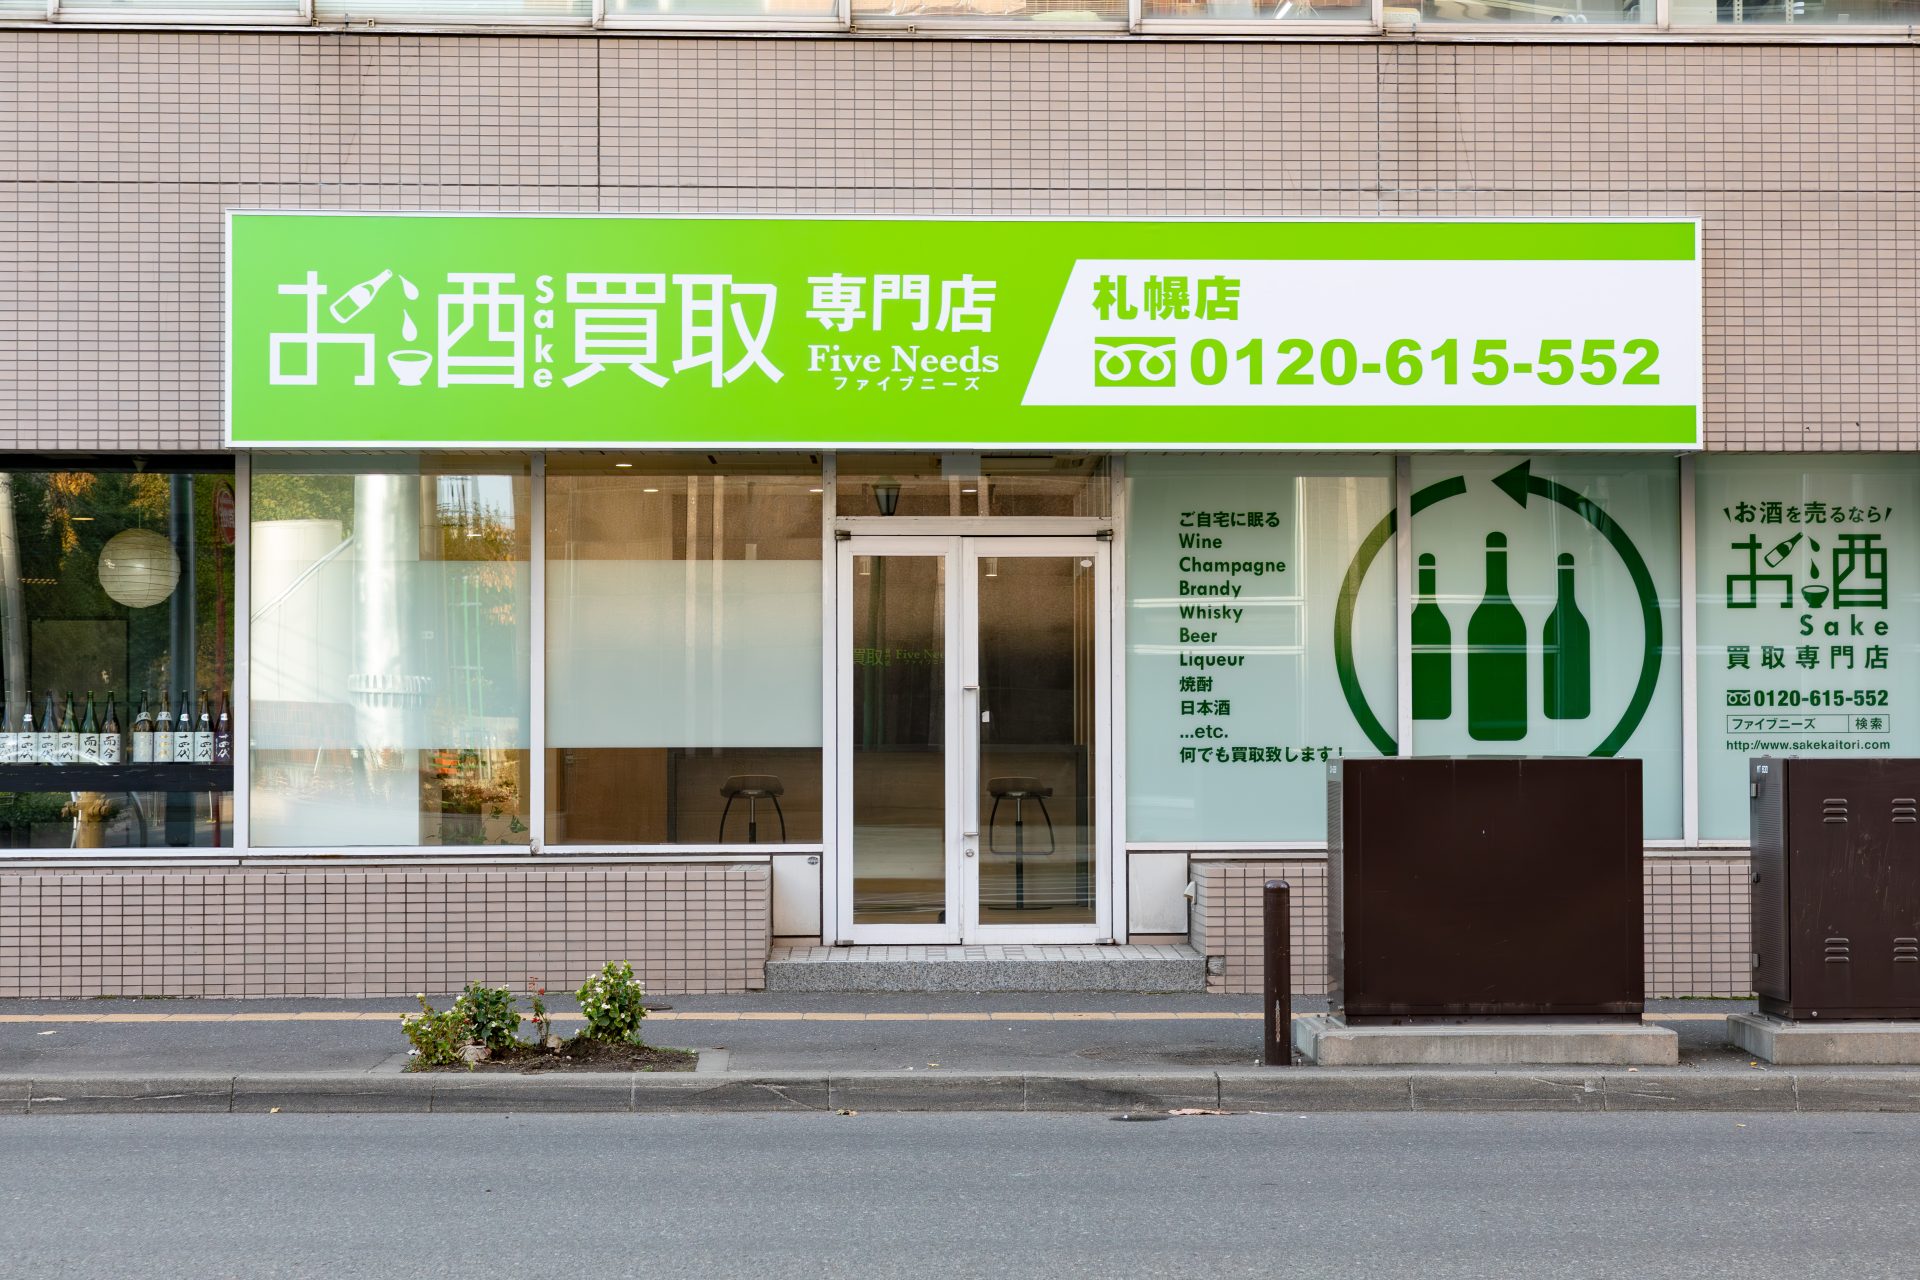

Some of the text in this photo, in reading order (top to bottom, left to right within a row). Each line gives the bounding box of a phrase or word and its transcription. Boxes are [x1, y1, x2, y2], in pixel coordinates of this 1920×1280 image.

[806, 273, 997, 333] 専門店
[1092, 274, 1241, 321] 札幌店
[533, 274, 555, 389] Sake
[562, 272, 785, 388] 買取
[807, 345, 999, 373] Five Needs
[1190, 338, 1660, 386] 0120-615-552
[834, 375, 980, 391] ファイブニーズ
[1179, 511, 1280, 528] ご自宅に眠る
[1179, 533, 1223, 549] Wine
[1179, 556, 1286, 576] Champagne
[1179, 580, 1242, 597] Brandy
[1179, 605, 1243, 623] Whisky
[1799, 614, 1889, 636] Sake
[1179, 627, 1218, 643] Beer
[1179, 652, 1245, 670] Liqueur
[1727, 645, 1889, 669] 買取専門店
[1179, 676, 1213, 692] 焼酎
[1753, 689, 1889, 707] 0120-615-552
[1181, 700, 1231, 716] 日本酒
[1732, 717, 1883, 730] ファイブニーズ 検索
[1726, 739, 1890, 751] http://www.sakekaitori.com
